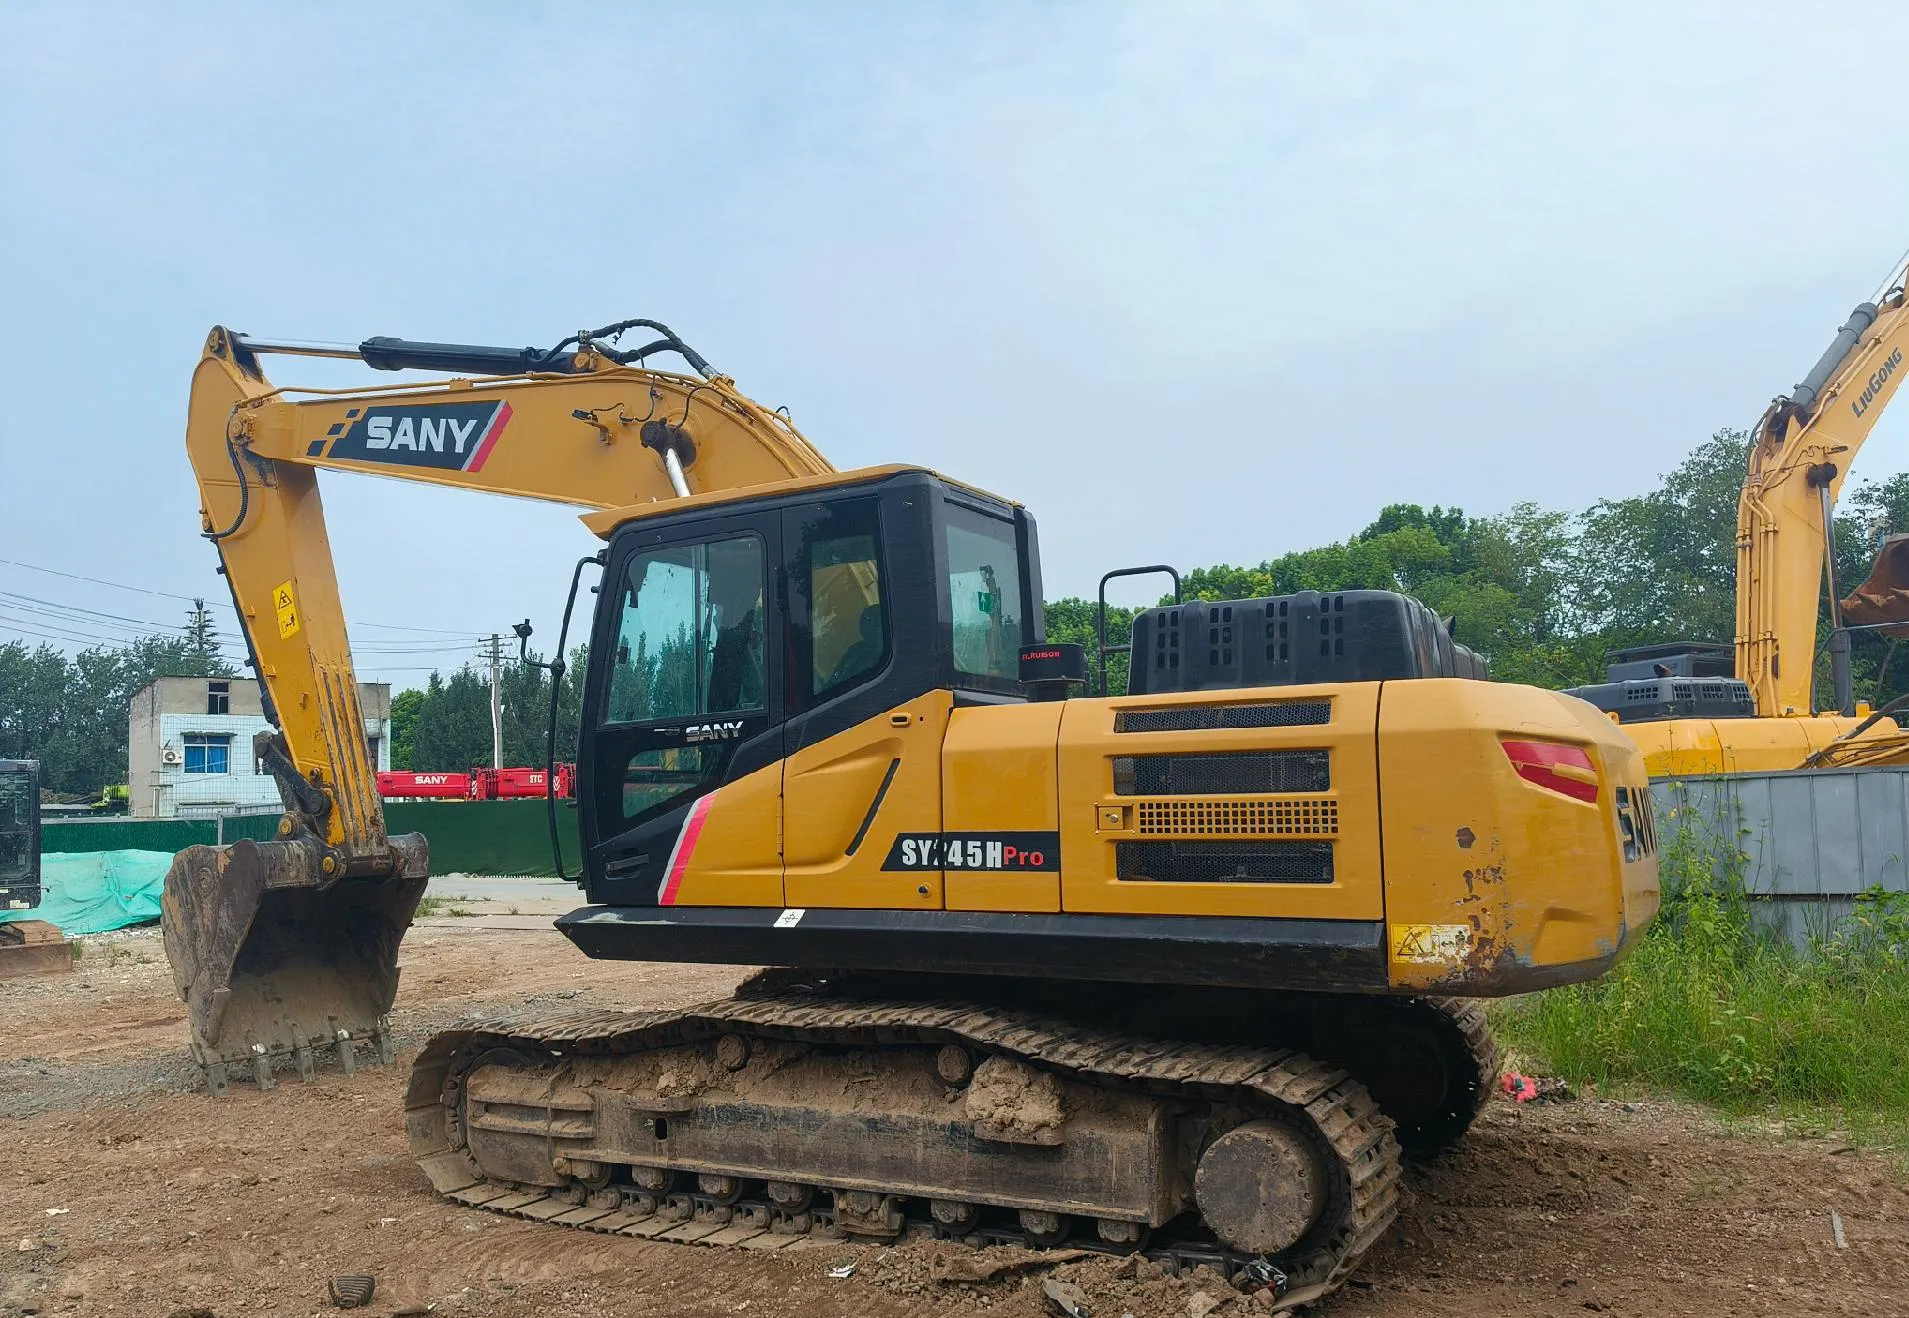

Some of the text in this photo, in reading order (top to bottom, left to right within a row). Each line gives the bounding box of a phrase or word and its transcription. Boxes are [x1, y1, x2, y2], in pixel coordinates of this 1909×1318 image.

[366, 416, 478, 453] SANY
[686, 721, 743, 742] SANY
[415, 775, 448, 785] SANY
[529, 774, 543, 783] STC
